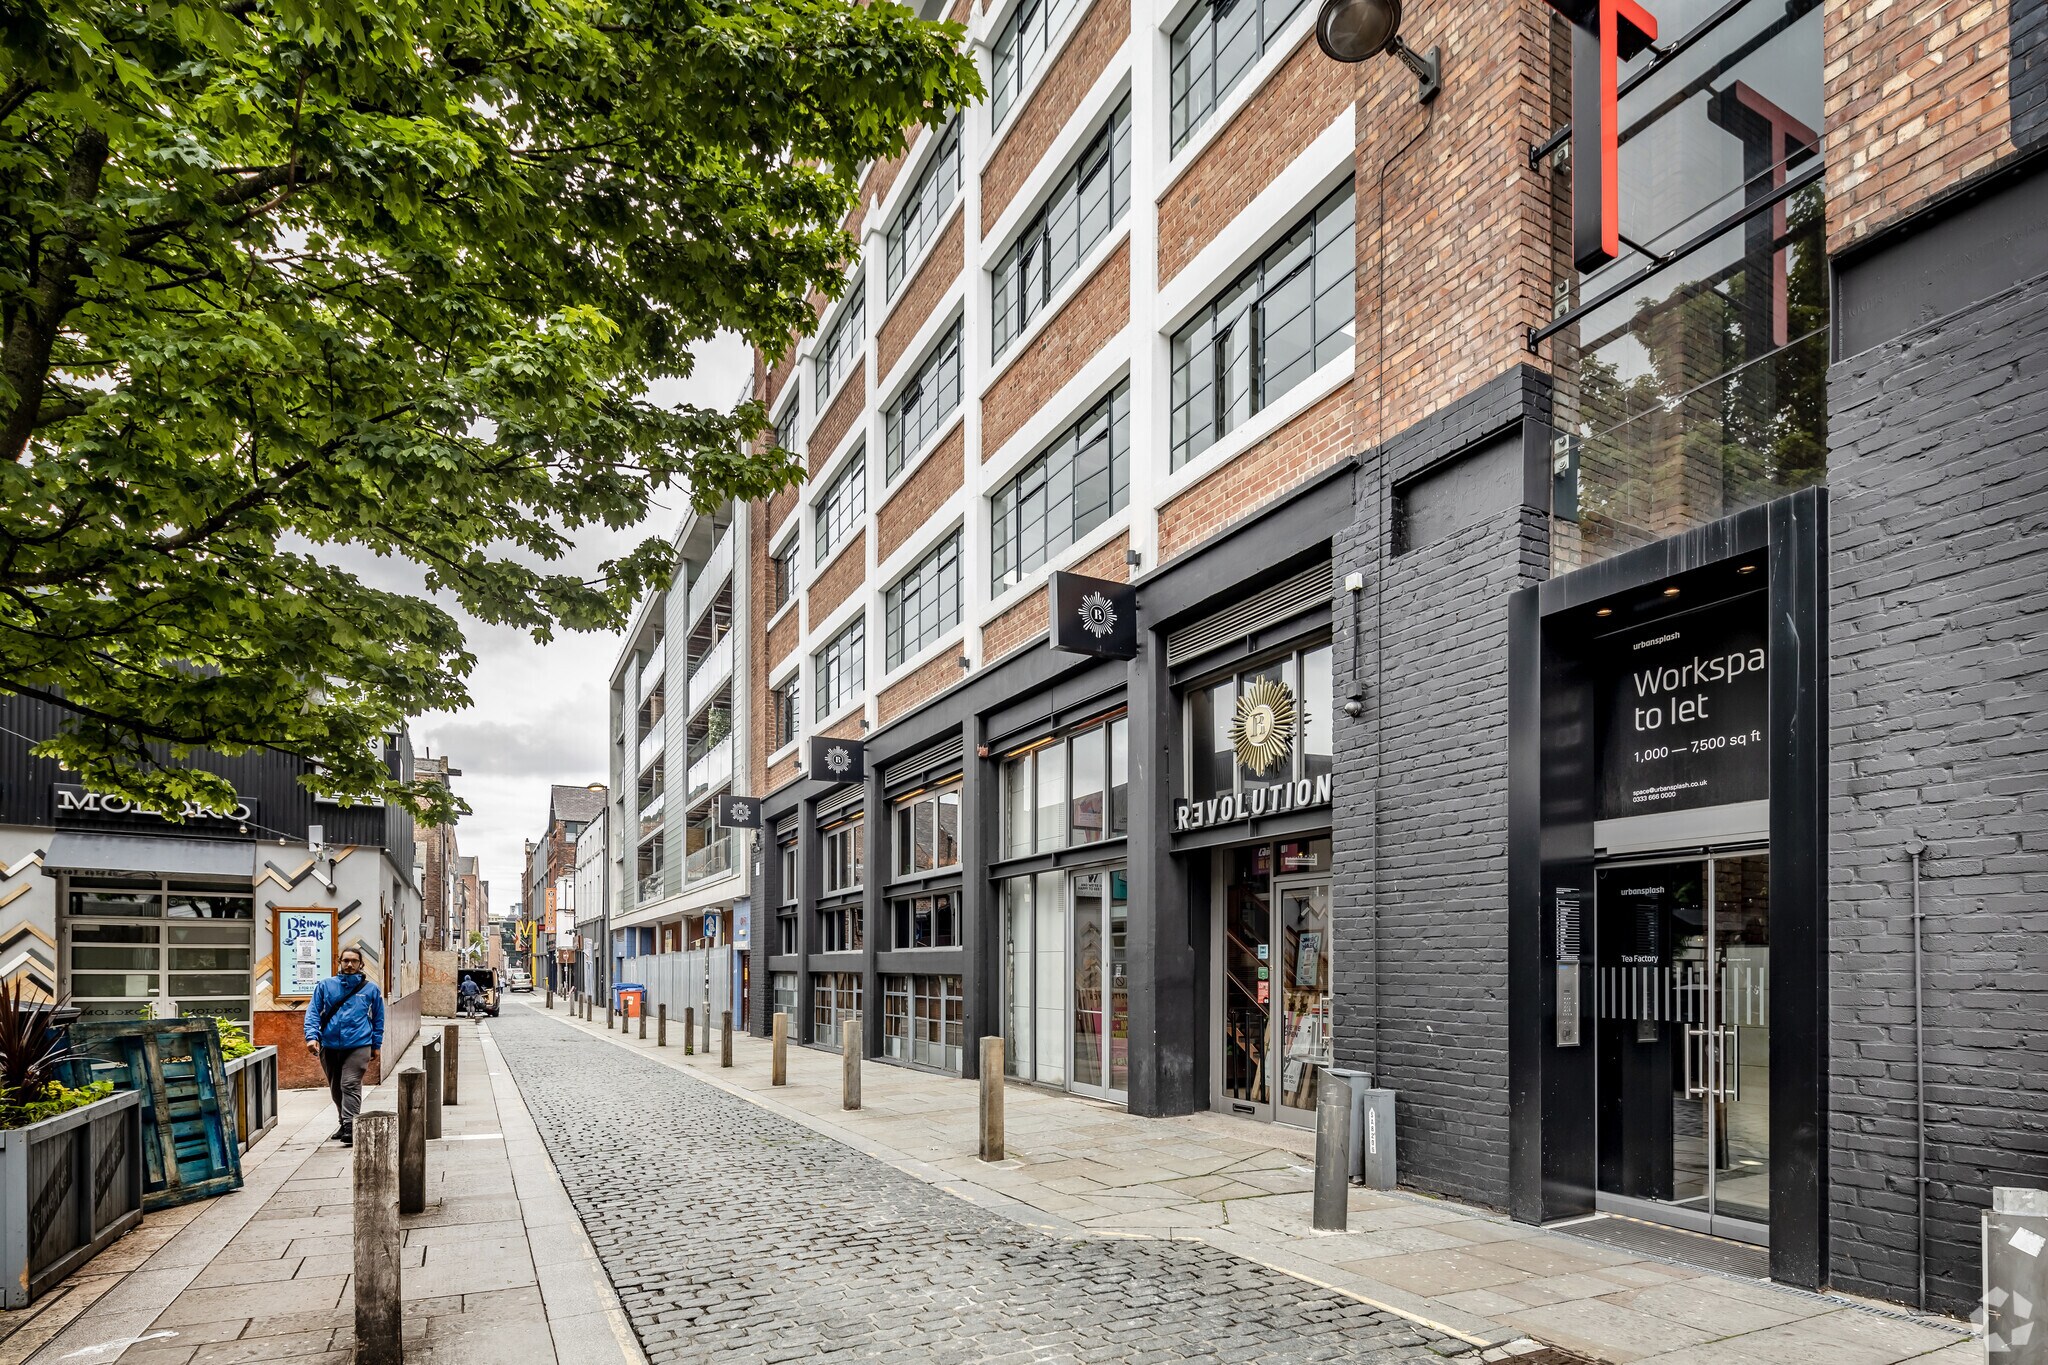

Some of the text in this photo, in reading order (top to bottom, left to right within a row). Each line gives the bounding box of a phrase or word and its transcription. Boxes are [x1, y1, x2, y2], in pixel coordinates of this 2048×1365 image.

[1632, 631, 1681, 651] urbansplash
[1634, 647, 1765, 698] Workspa
[1635, 693, 1709, 731] to let
[1634, 746, 1669, 763] 1,000
[1690, 736, 1726, 754] 7,500
[1729, 733, 1747, 747] sq
[1750, 729, 1762, 743] ft
[1632, 779, 1708, 797] space@urbansplash.co.uk
[1621, 885, 1665, 897] urbansplash
[287, 918, 329, 930] DRINK
[1621, 955, 1659, 964] Tea Factory
[184, 1007, 242, 1015] MOLOKO
